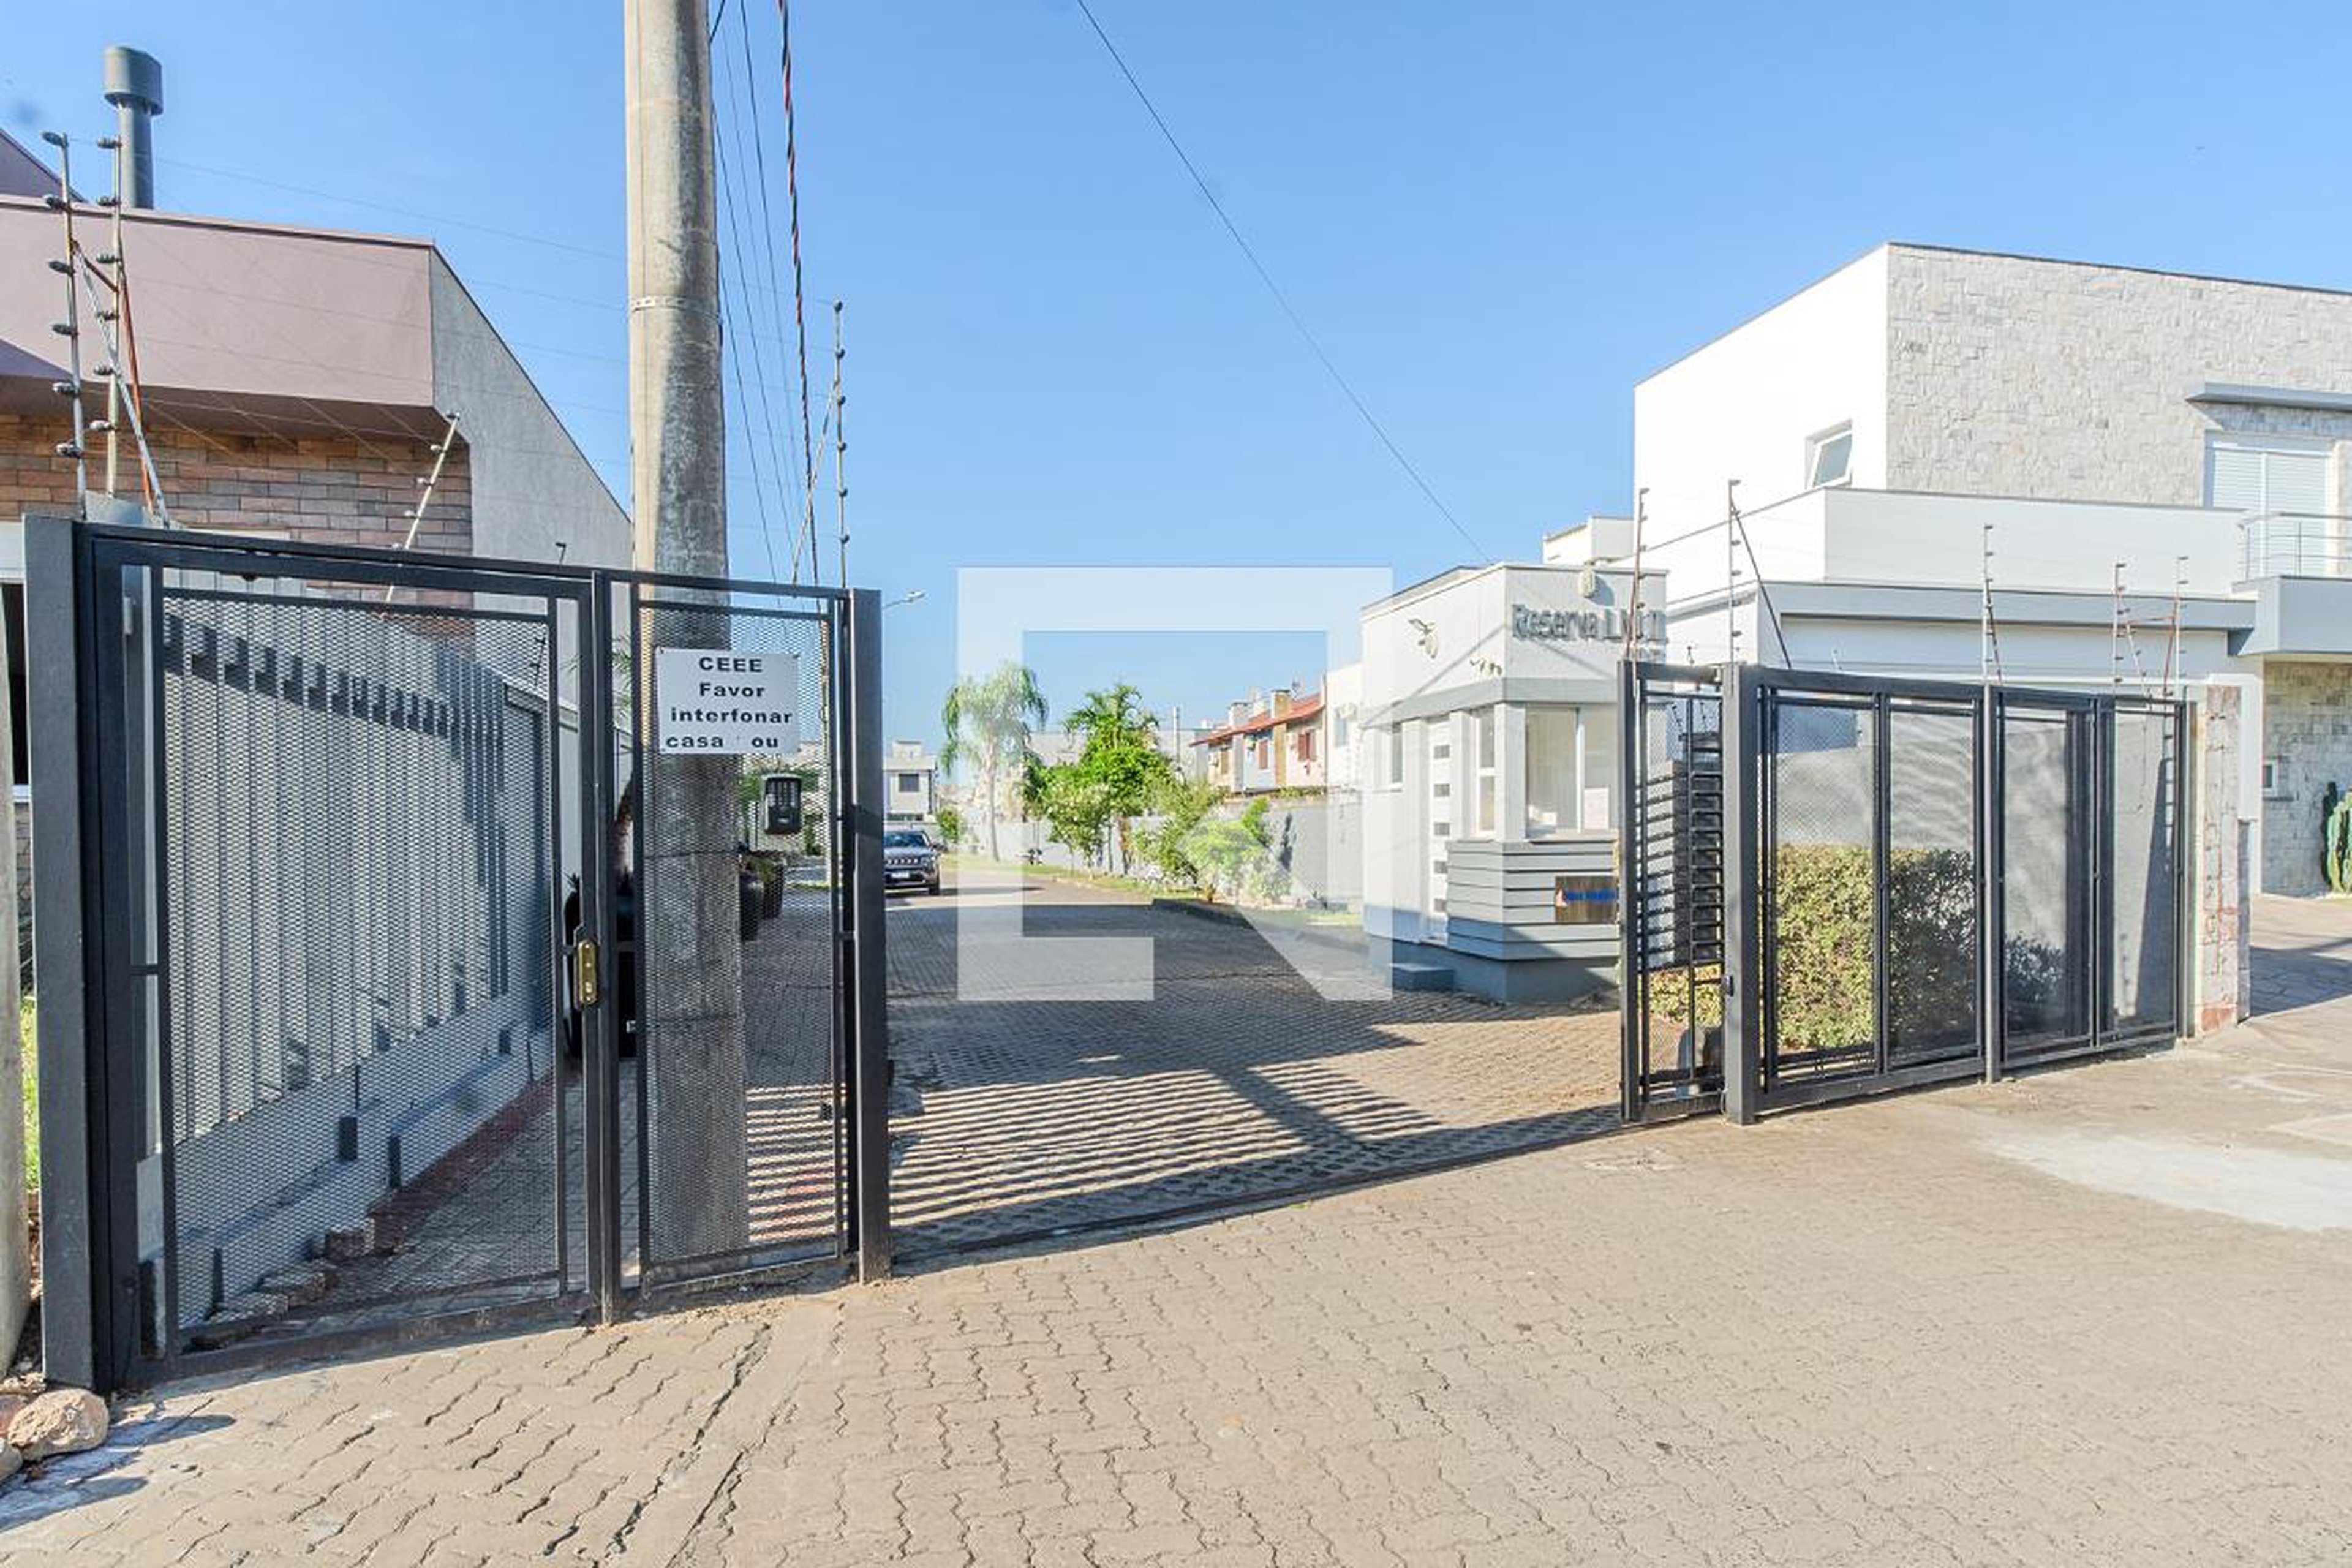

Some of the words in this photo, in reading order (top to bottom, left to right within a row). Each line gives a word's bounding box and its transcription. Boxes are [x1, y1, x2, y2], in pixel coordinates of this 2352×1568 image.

[698, 657, 764, 673] CEEE
[699, 681, 766, 698] Favor
[670, 707, 793, 724] interfonar
[666, 736, 724, 748] casa
[750, 736, 780, 748] ou
